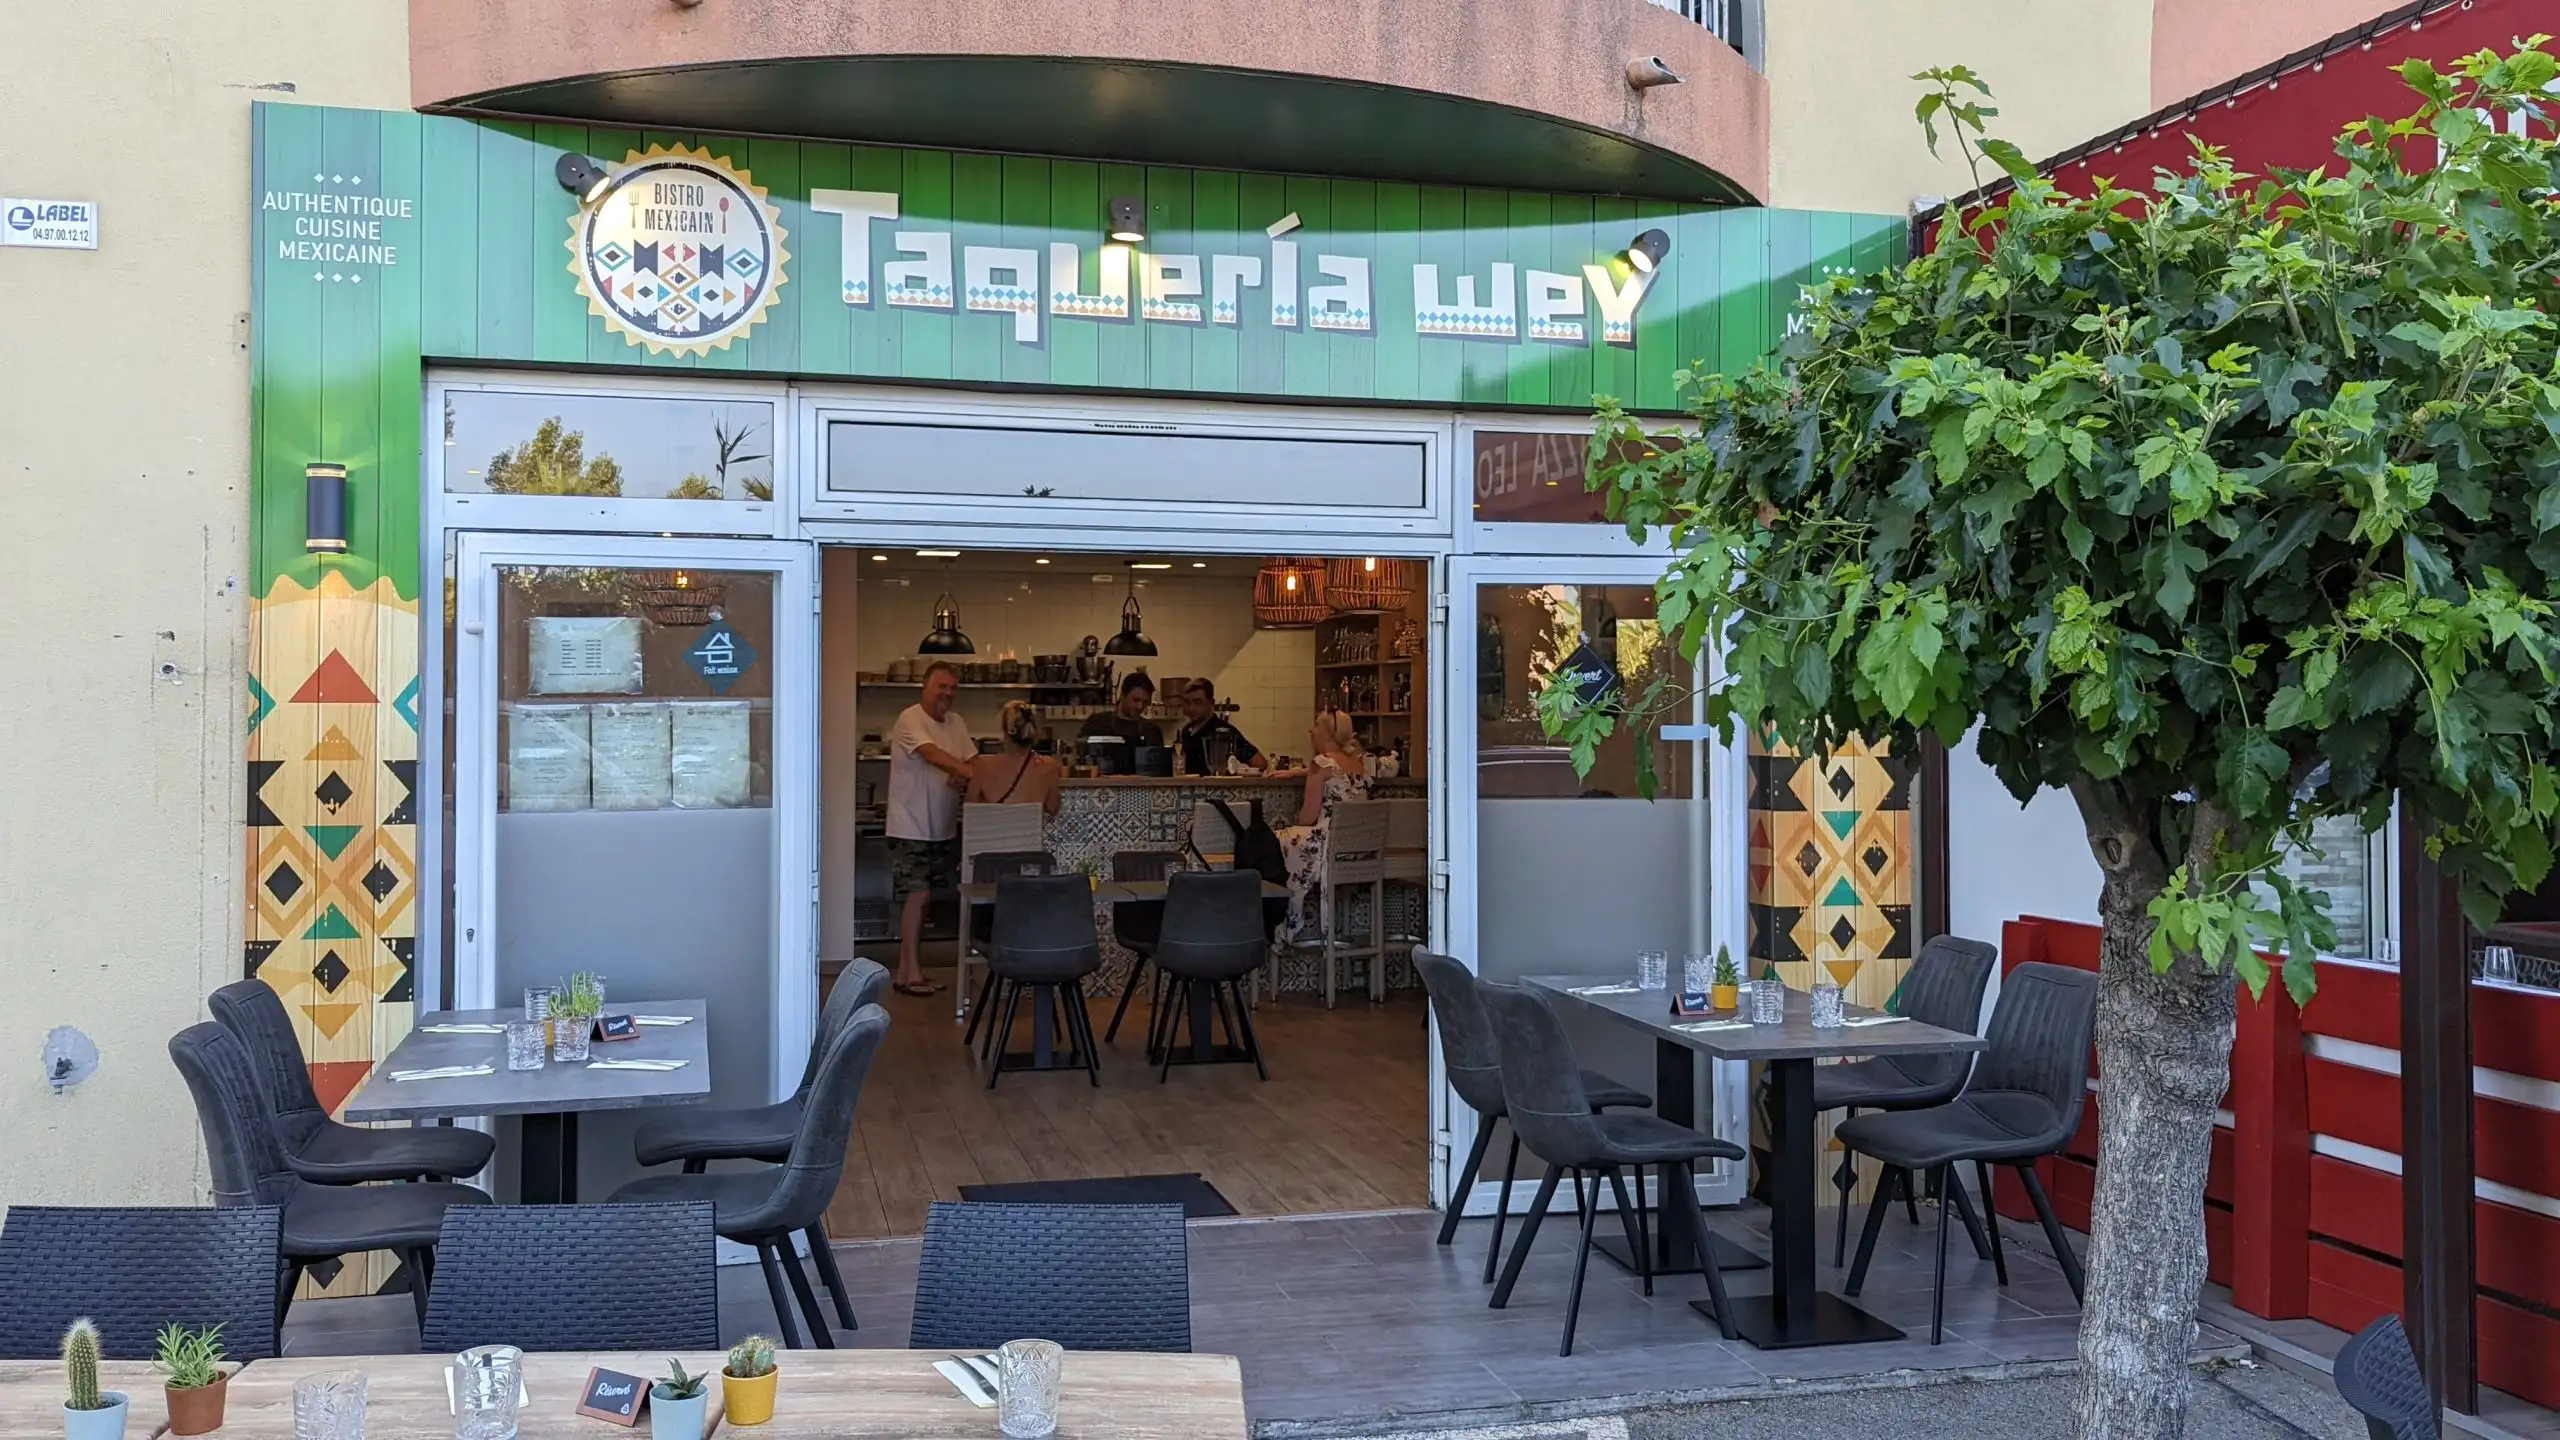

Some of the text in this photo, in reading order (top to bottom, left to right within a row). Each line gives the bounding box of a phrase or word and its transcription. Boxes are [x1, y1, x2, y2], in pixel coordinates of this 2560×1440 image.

[262, 190, 413, 218] AUTHENTIQUE
[654, 182, 705, 208] BISTRO
[36, 203, 88, 222] LABEL
[644, 208, 714, 234] MEXICAIN
[32, 227, 90, 242] 04.97.00.12.12
[295, 216, 382, 241] CUISINE
[279, 240, 397, 265] MEXICAINE
[810, 187, 1372, 343] Taquería
